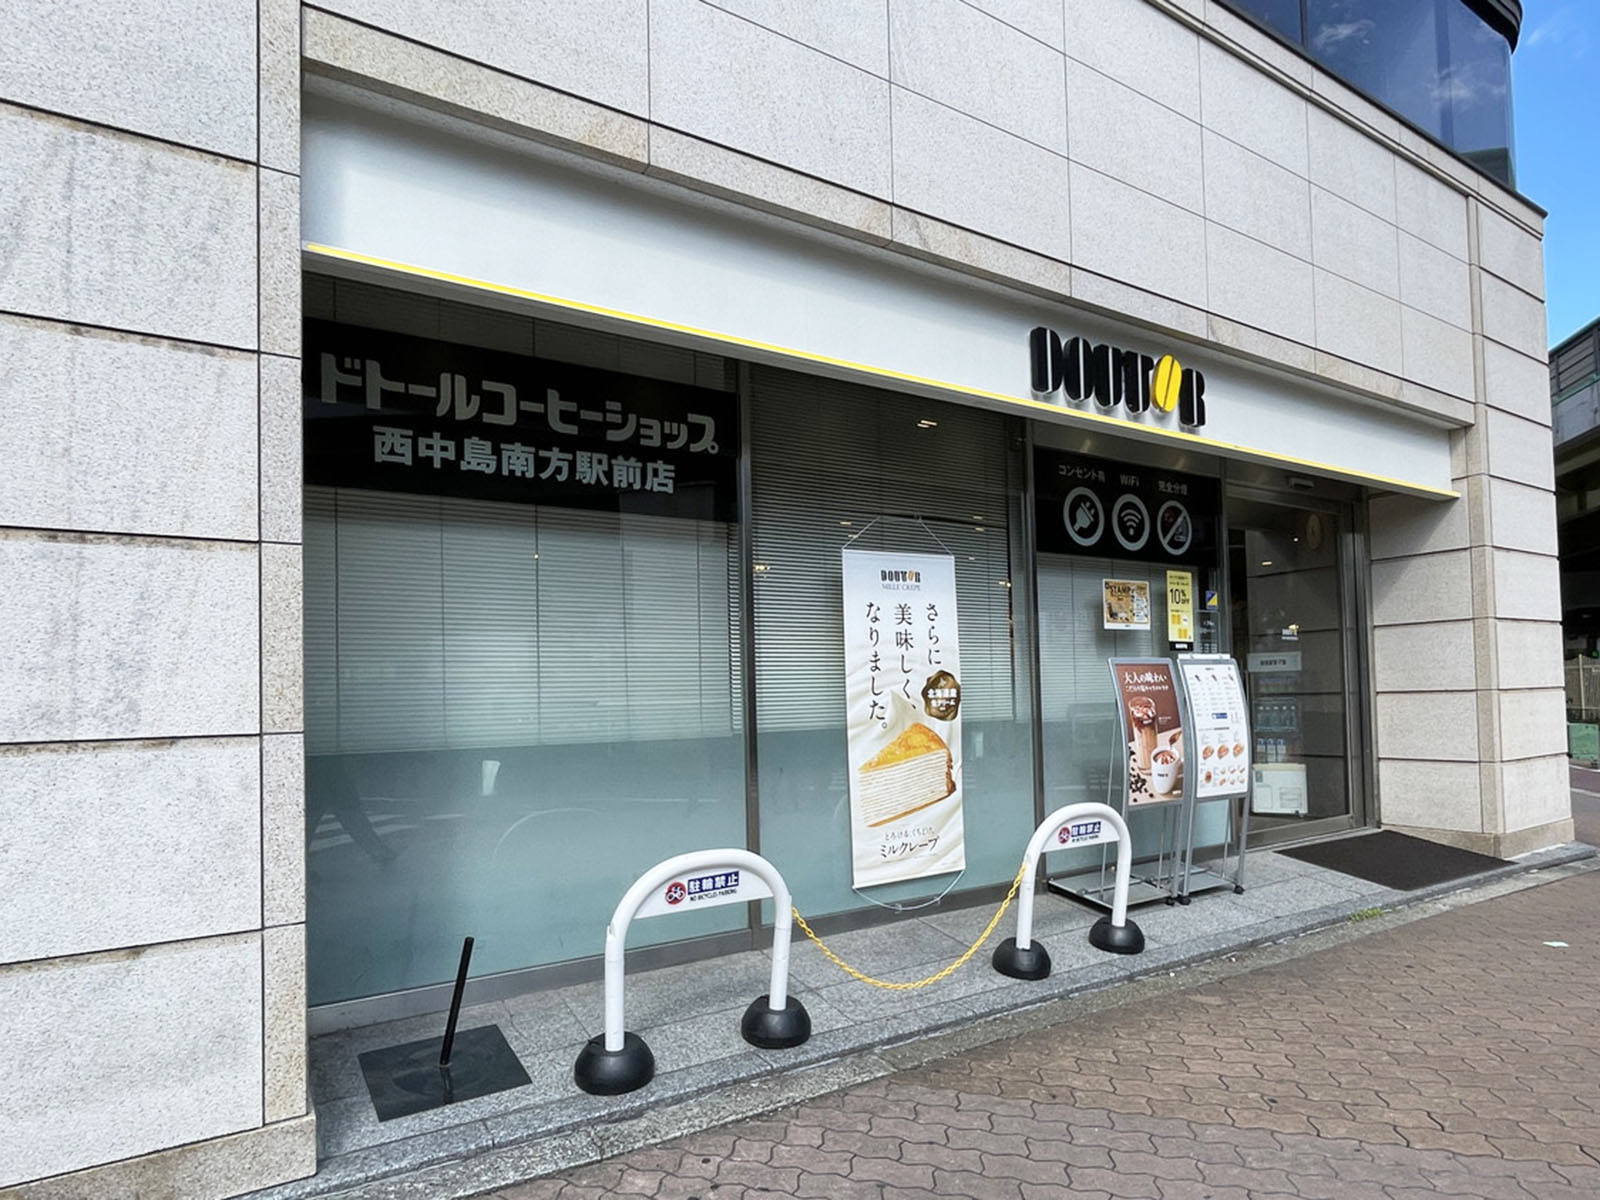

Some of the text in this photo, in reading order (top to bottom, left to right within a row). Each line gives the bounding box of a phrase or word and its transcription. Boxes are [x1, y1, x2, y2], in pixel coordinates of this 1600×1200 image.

[320, 352, 720, 455] ドトールコーヒーショップ
[1029, 326, 1206, 428] DOUTOR
[372, 425, 676, 495] 西中島南方駅前店
[880, 569, 921, 583] DOUTOR
[866, 602, 888, 729] なりました。
[894, 603, 917, 710] 美味しく、
[925, 602, 942, 665] さらに
[880, 835, 940, 858] ミルクレープ
[688, 873, 738, 893] 駐輪禁止
